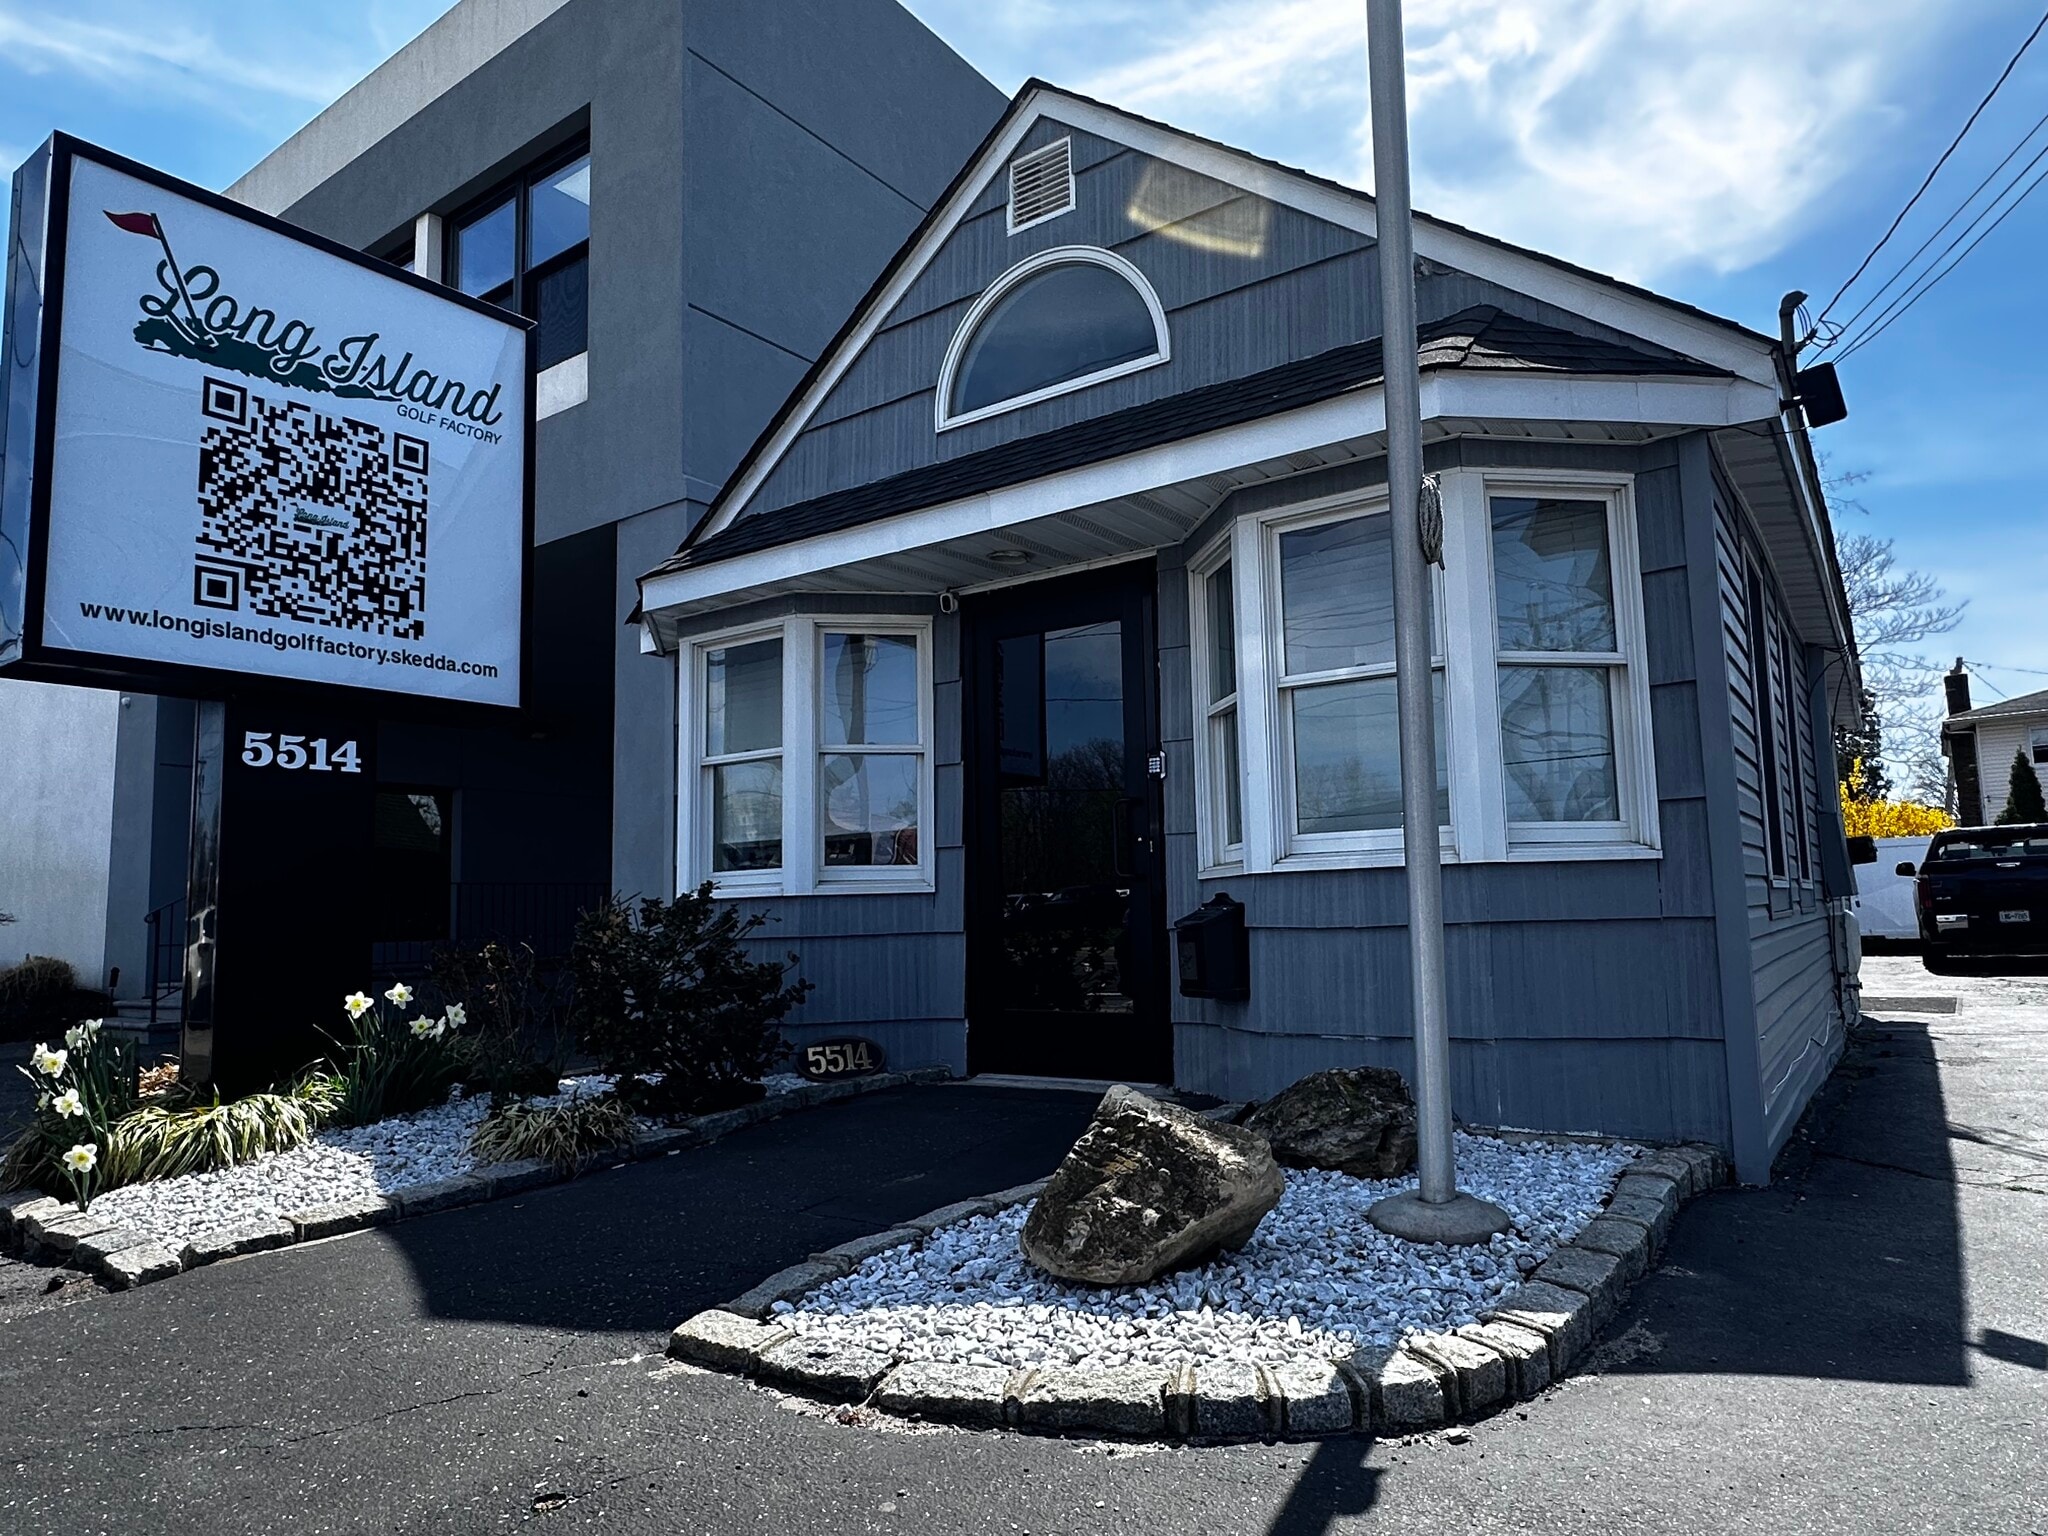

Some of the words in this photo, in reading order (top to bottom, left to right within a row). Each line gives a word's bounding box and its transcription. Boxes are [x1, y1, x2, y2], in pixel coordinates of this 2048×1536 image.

[139, 259, 321, 373] Long
[322, 332, 503, 426] Island
[396, 404, 437, 425] GOLF
[439, 417, 502, 445] FACTORY
[80, 602, 498, 678] www.longislandgolffactory.skedda.com
[241, 731, 362, 773] 5514
[806, 1042, 874, 1075] 5514
